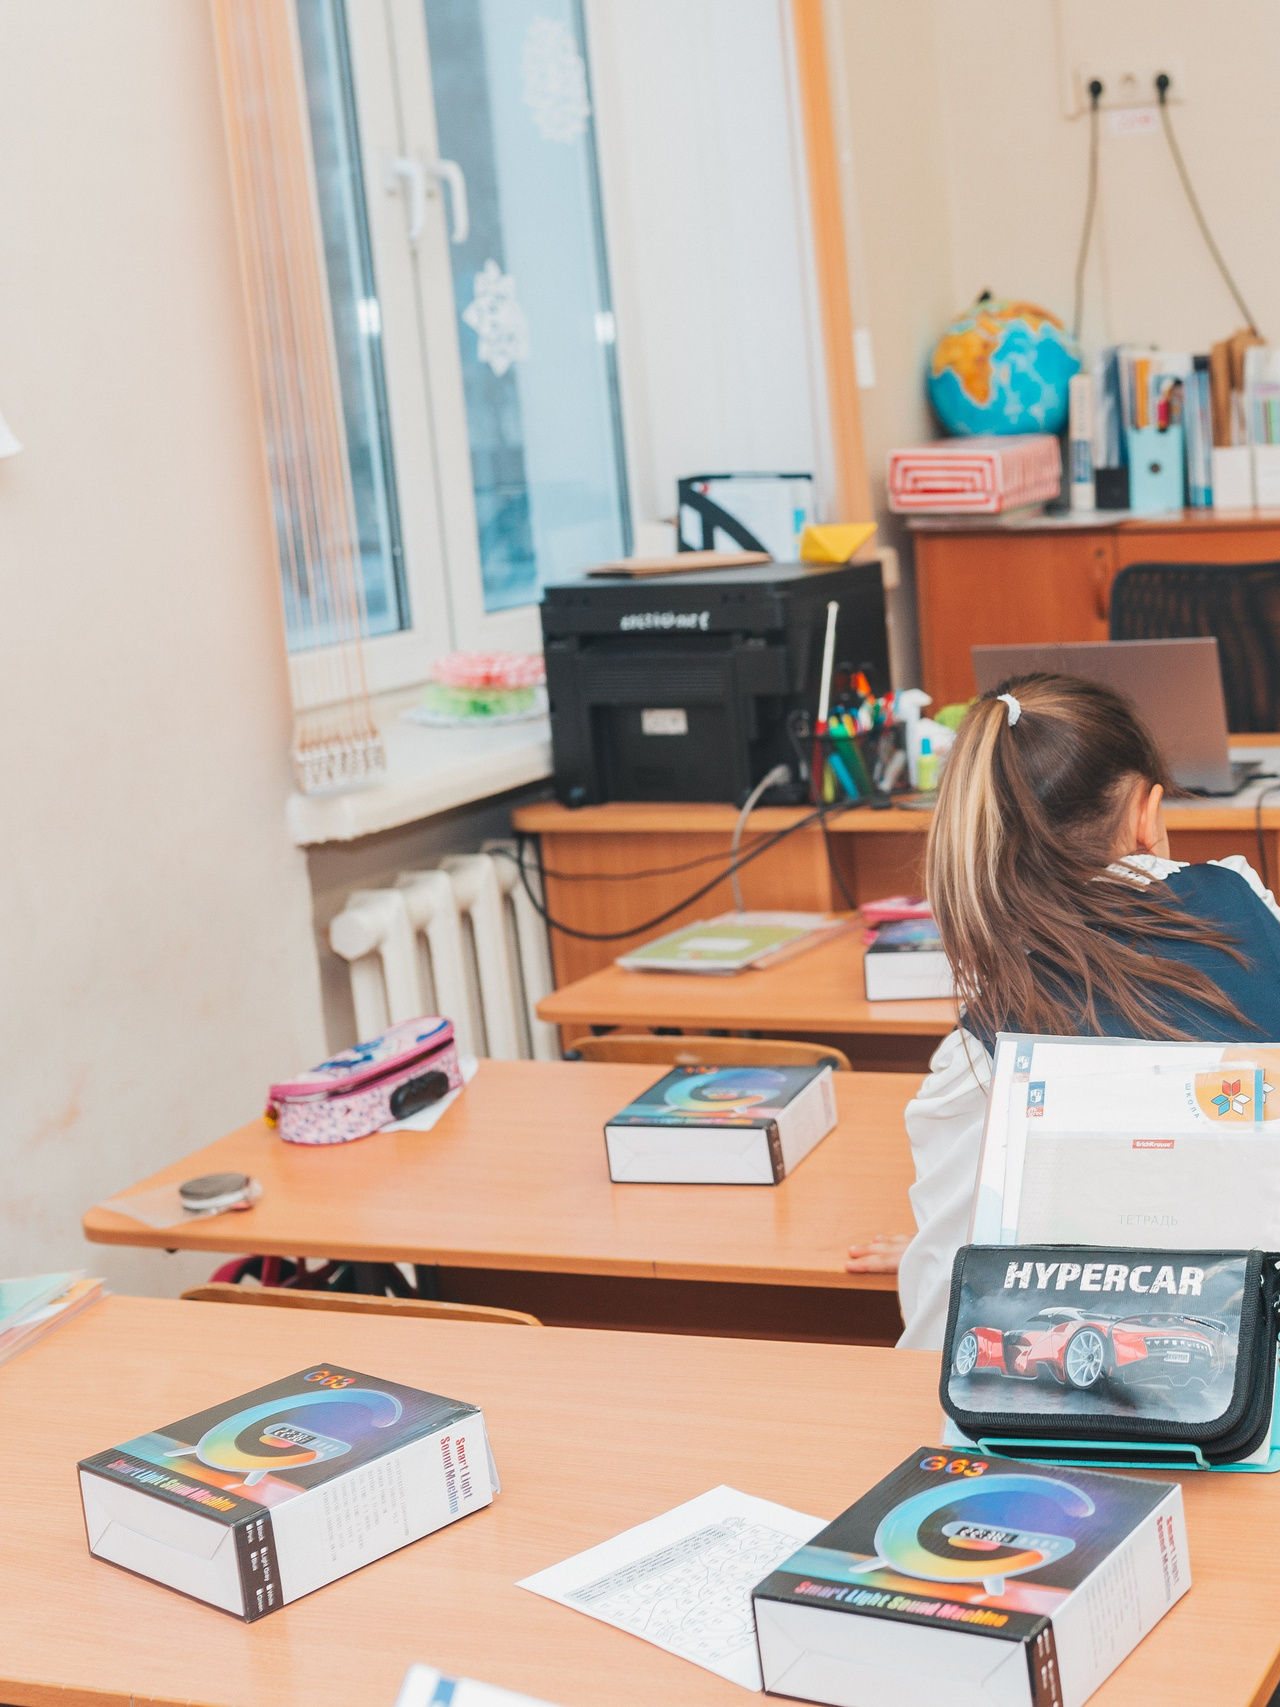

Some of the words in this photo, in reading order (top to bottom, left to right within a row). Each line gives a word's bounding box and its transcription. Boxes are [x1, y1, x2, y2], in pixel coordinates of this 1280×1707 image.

[1185, 1083, 1200, 1119] ШКОЛА
[1118, 1214, 1178, 1227] ТЕТРАДЬ
[1003, 1261, 1204, 1297] HYPERCAR
[303, 1369, 356, 1389] G63
[440, 1436, 454, 1470] Sound
[455, 1437, 469, 1472] Smart
[919, 1455, 989, 1477] G63
[106, 1459, 146, 1478] Smart
[135, 1469, 170, 1486] Light
[159, 1479, 201, 1497] Sound
[187, 1488, 238, 1512] Machine
[445, 1468, 459, 1515] Machine
[461, 1470, 473, 1500] Light
[794, 1580, 850, 1600] Smart
[844, 1588, 891, 1608] Light
[887, 1596, 942, 1617] Sound
[936, 1603, 1009, 1628] Machine
